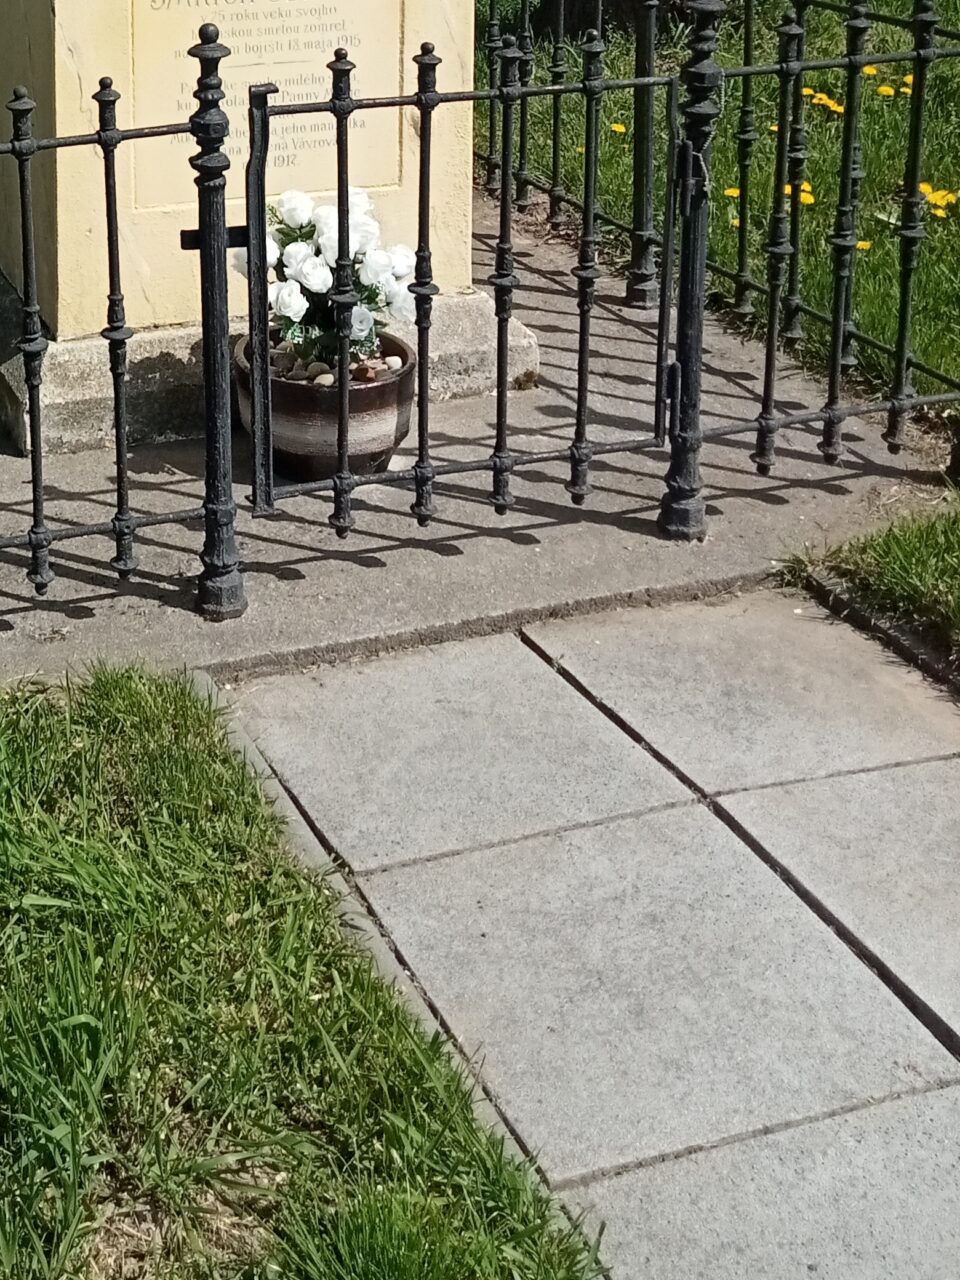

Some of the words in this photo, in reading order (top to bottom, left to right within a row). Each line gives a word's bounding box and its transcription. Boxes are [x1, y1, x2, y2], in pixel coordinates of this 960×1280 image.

[230, 8, 259, 22] roku
[262, 6, 292, 20] veku
[295, 3, 337, 22] svojho
[336, 33, 362, 48] 1915
[281, 122, 307, 138] jeho
